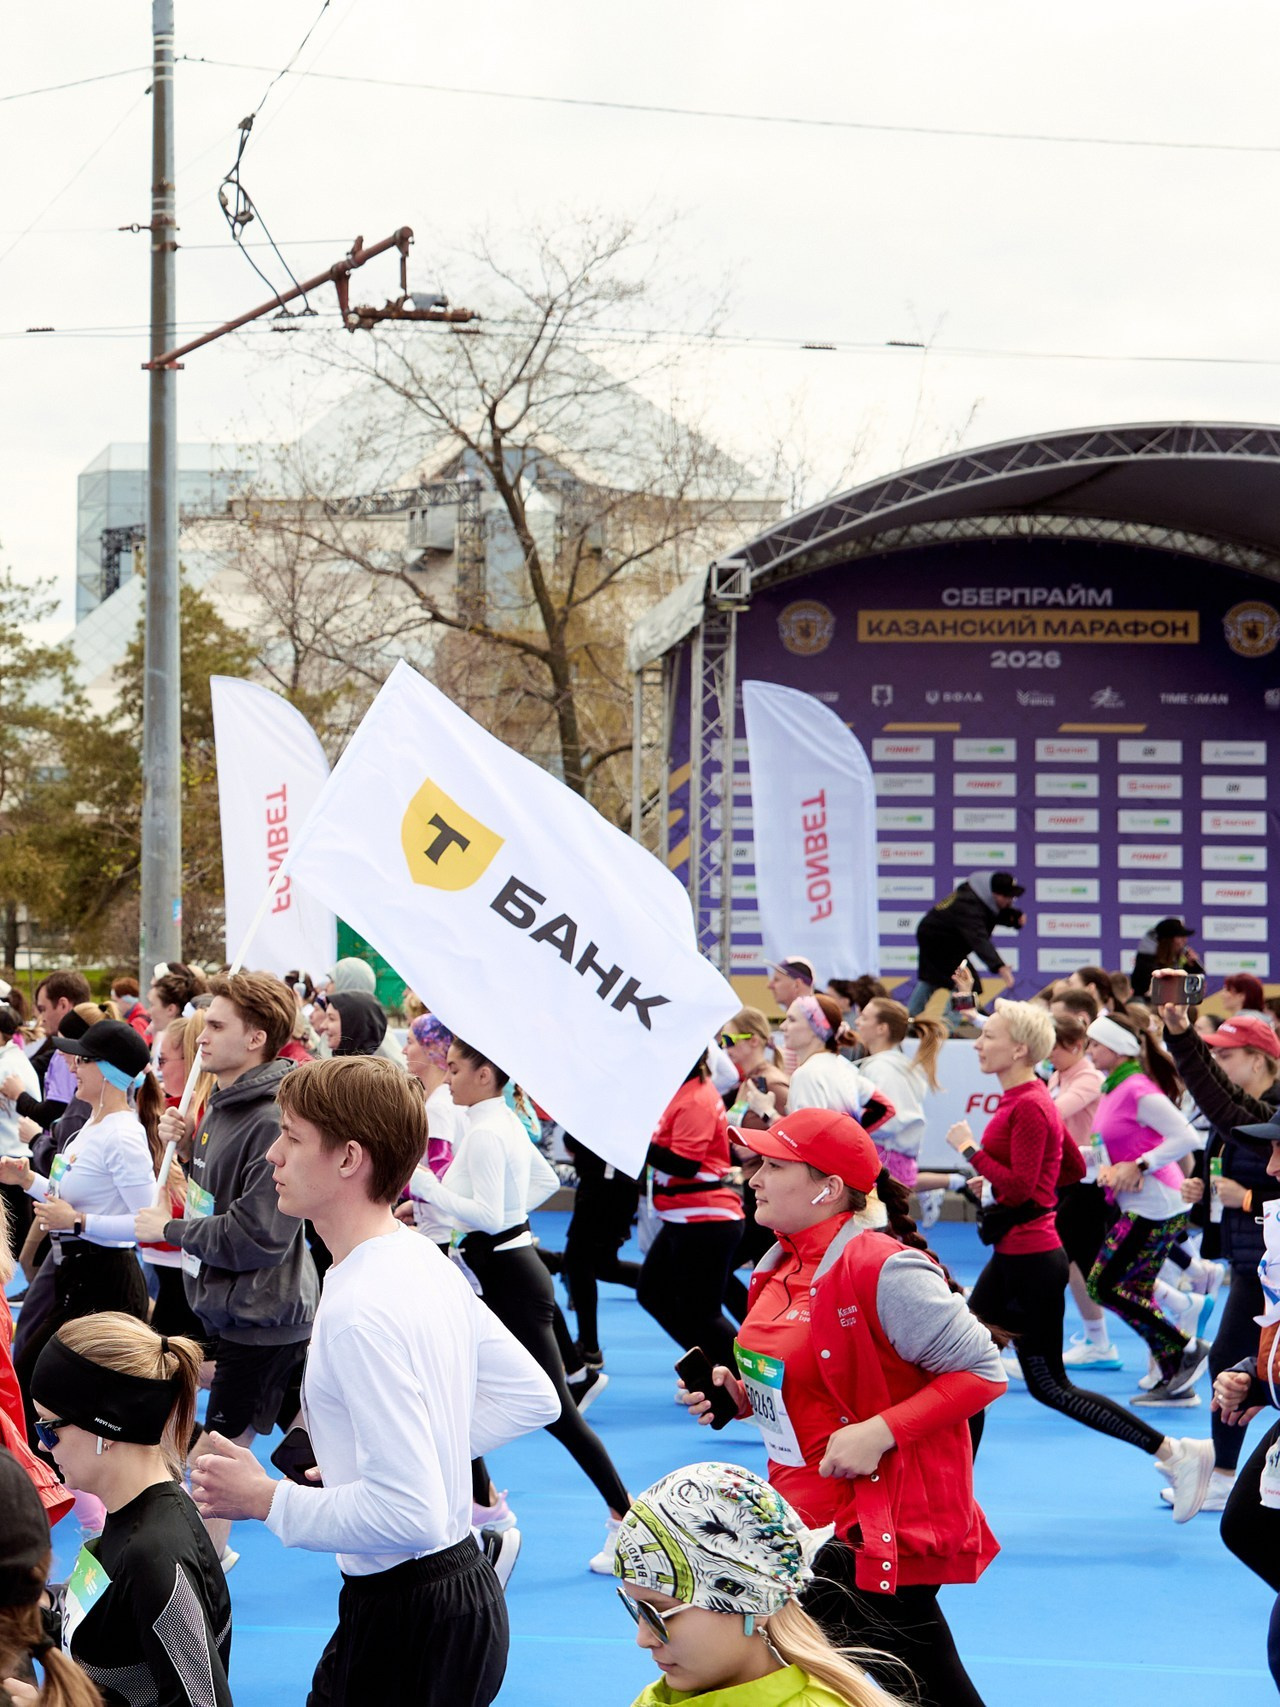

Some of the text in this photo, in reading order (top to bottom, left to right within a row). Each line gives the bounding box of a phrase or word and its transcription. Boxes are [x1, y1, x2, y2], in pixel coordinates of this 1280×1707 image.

[942, 584, 1113, 606] СБЕРПРАЙМ
[867, 615, 1190, 637] КАЗАНСКИЙ МАРАФОН
[991, 651, 1062, 669] 2026
[489, 875, 672, 1031] БАНК
[620, 1531, 648, 1578] BANDITS
